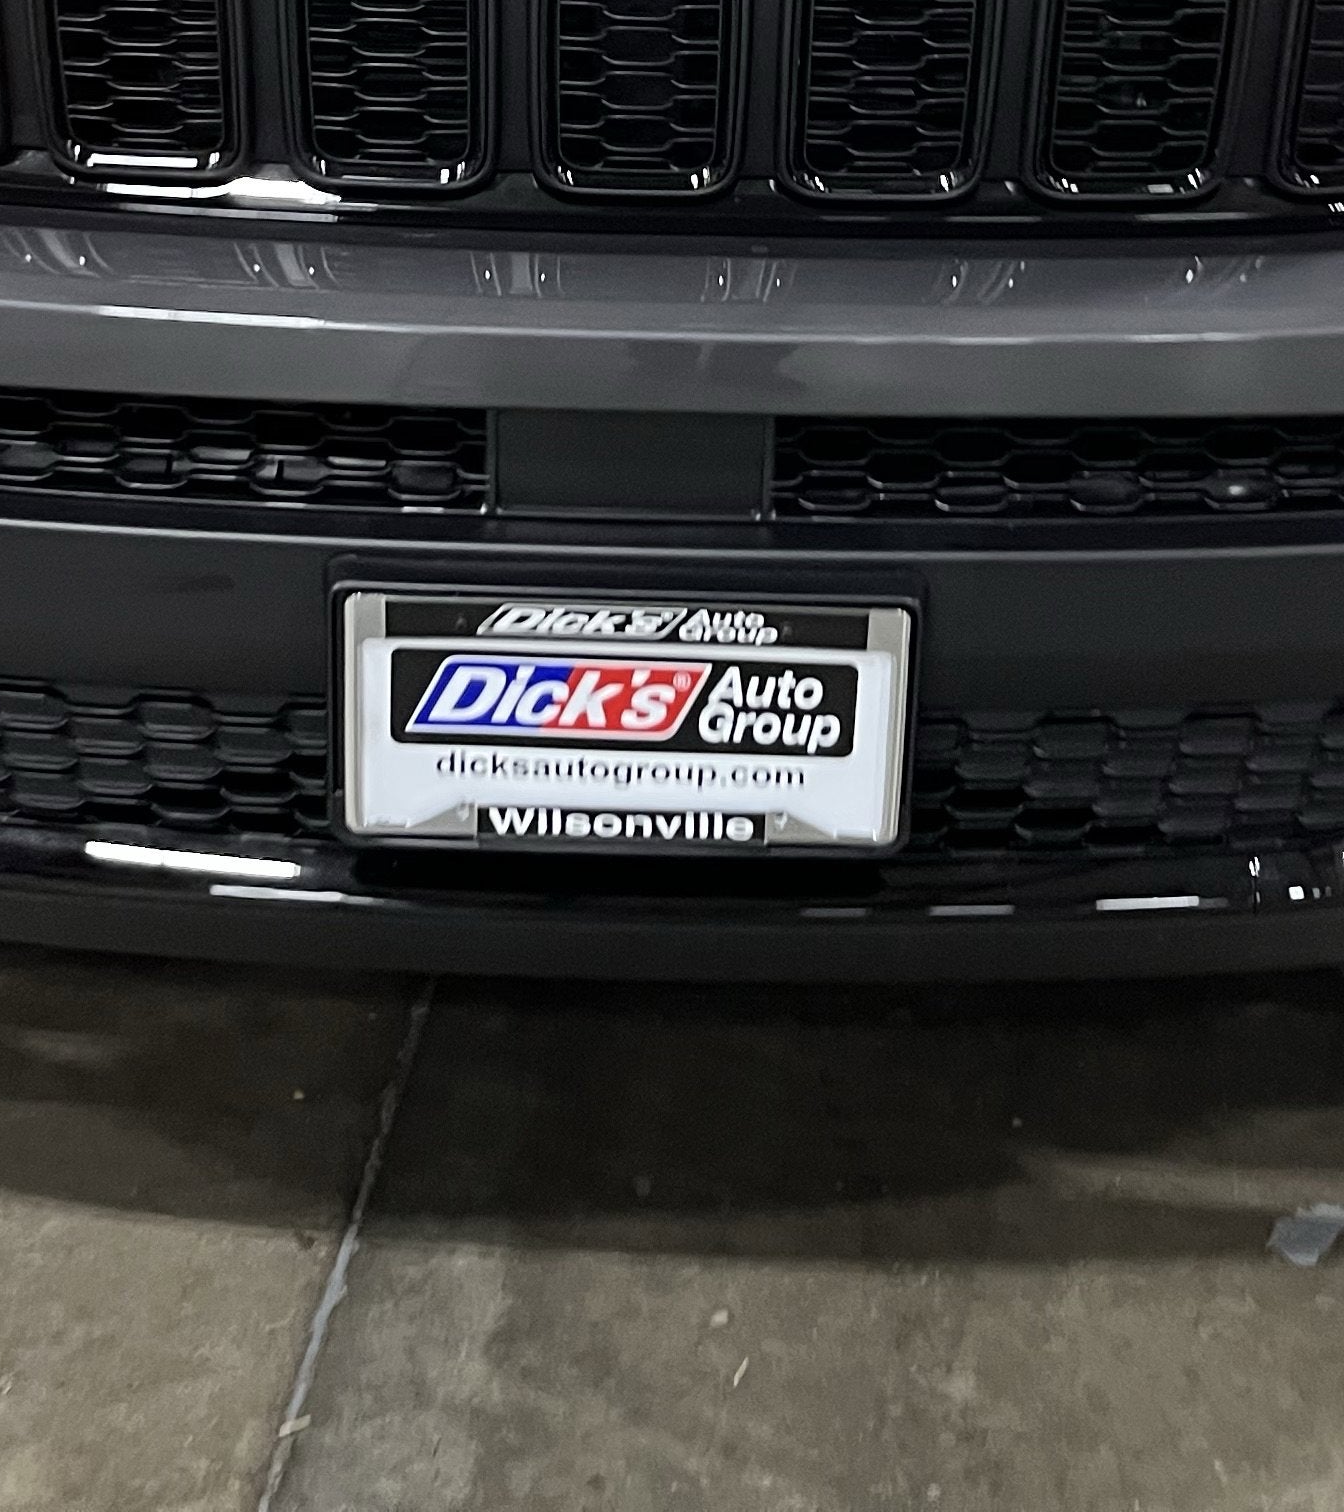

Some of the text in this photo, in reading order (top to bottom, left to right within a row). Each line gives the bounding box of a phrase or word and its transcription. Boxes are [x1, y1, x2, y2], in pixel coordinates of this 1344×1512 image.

[708, 665, 824, 710] Auto
[698, 701, 842, 755] Group
[436, 749, 805, 790] dicksautogroup.com
[488, 807, 755, 842] Wilsonville
